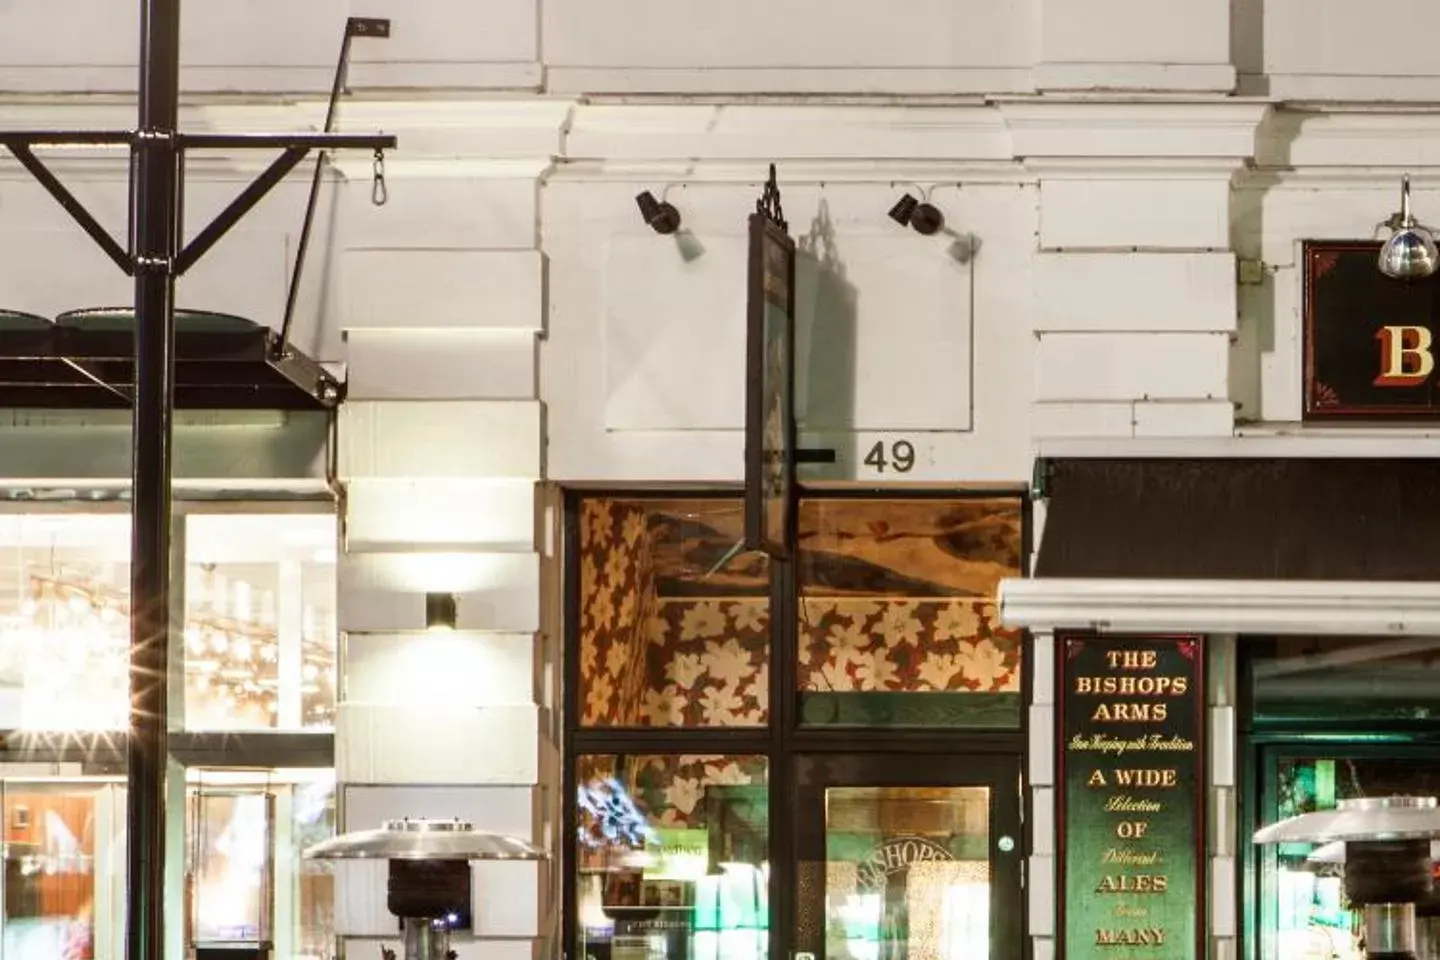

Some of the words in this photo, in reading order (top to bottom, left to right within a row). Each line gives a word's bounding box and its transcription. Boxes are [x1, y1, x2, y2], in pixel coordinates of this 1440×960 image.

[863, 440, 915, 473] 49
[1106, 650, 1157, 669] THE
[1076, 676, 1188, 694] BISHOPS
[1092, 703, 1168, 721] ARMS
[1088, 769, 1107, 786] A
[1114, 768, 1177, 787] WIDE
[1104, 795, 1161, 812] Selection
[1116, 821, 1148, 838] OF
[1095, 875, 1168, 893] ALES
[1096, 926, 1167, 946] MANY
